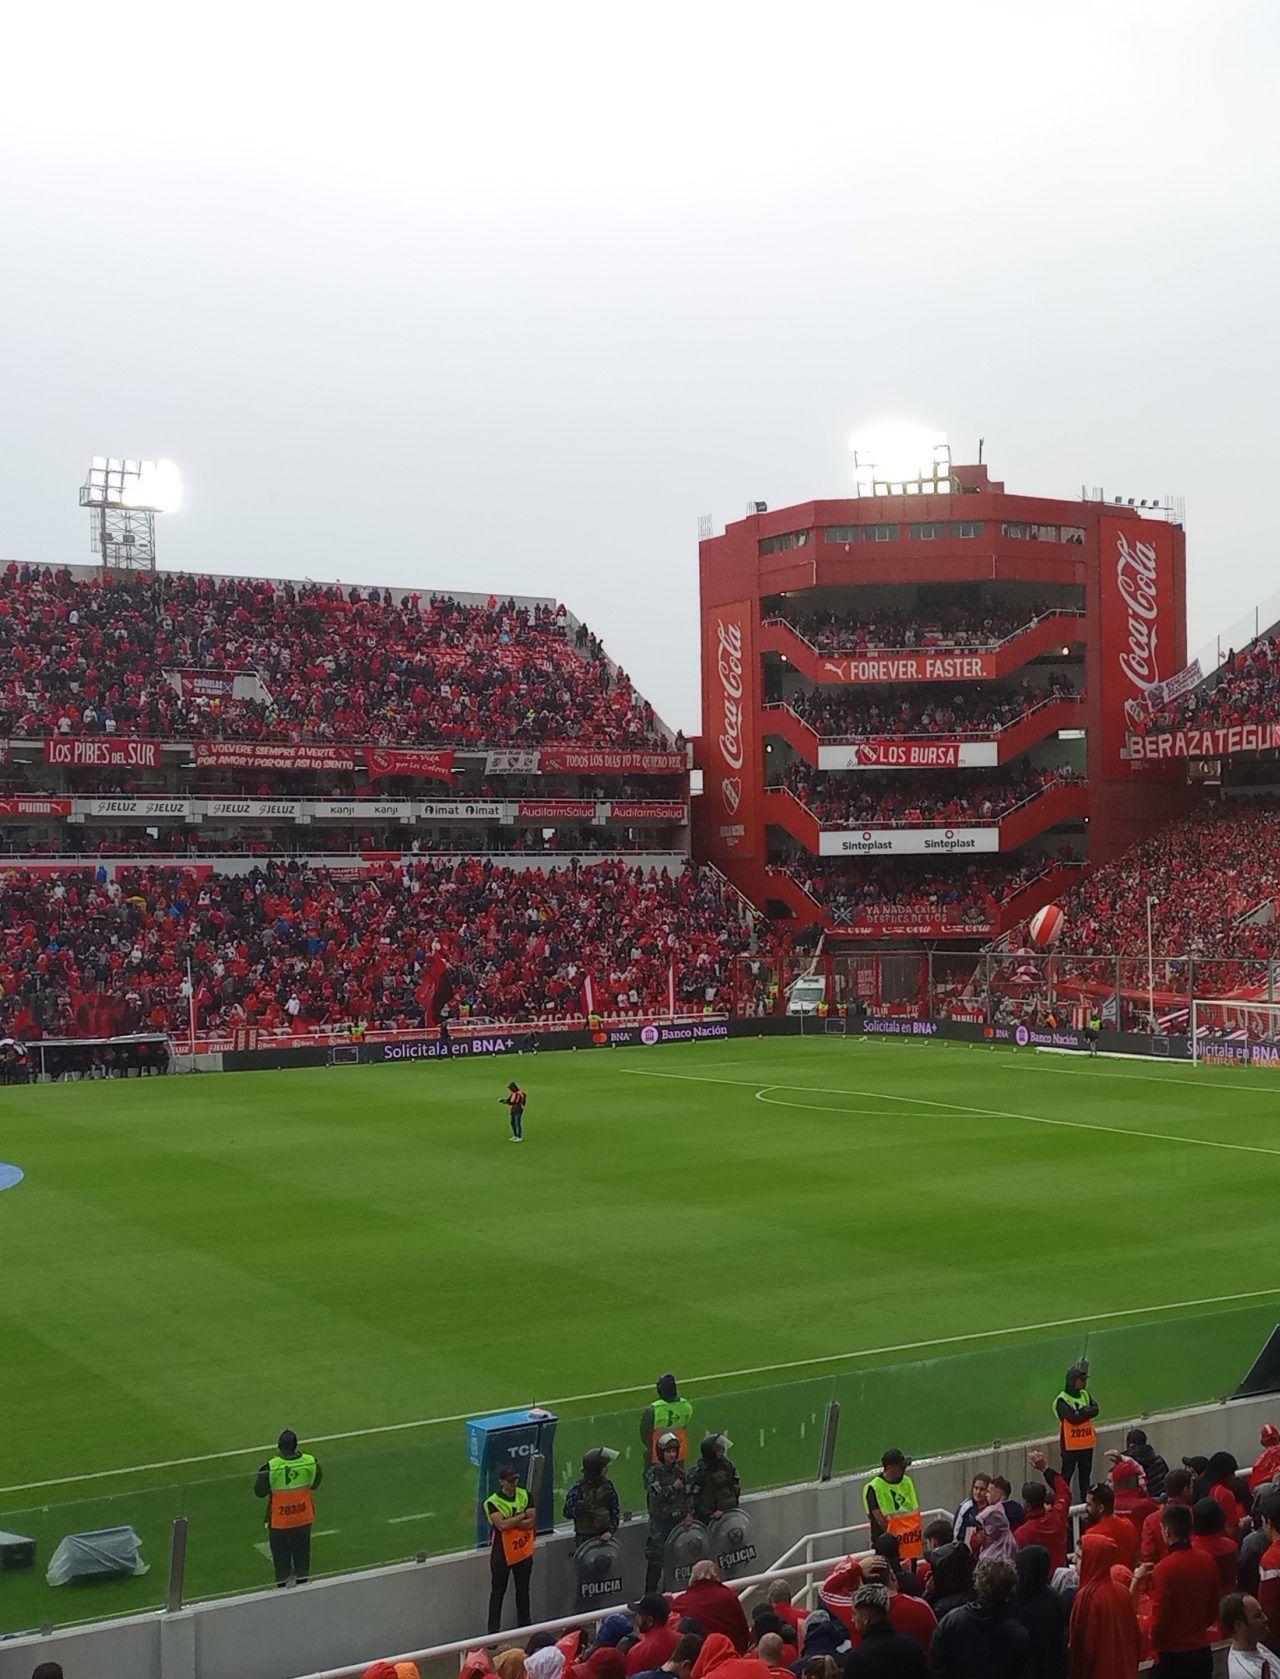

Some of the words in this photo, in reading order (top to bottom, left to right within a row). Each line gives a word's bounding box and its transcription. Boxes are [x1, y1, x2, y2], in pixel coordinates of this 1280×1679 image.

[850, 661, 922, 679] FOREVER.
[926, 658, 987, 678] FASTER.
[718, 618, 743, 770] Coca-Cola
[49, 741, 70, 763] LOS
[74, 741, 109, 764] PIBES
[111, 752, 126, 764] DEL
[128, 743, 155, 766] SUR
[211, 744, 253, 754] VOLVERE
[255, 746, 295, 756] SIEMPRE
[880, 749, 906, 764] LOS
[911, 747, 954, 765] BURSA
[196, 757, 216, 765] POR
[217, 757, 246, 766] AMOR
[323, 761, 354, 770] SIENTO
[590, 754, 602, 767] LOS
[18, 802, 50, 812] PUMA
[106, 802, 137, 812] JELUZ
[153, 803, 184, 813] JELUZ
[221, 804, 250, 813] JELUZ
[267, 805, 295, 814] JELUZ
[842, 840, 892, 851] Sinteplast
[924, 839, 975, 849] Sinteplast
[662, 1028, 692, 1040] Banco
[693, 1025, 727, 1038] Nación
[863, 1020, 900, 1033] Solicitala
[901, 1023, 911, 1033] en
[913, 1021, 938, 1034] BNA+
[1030, 1031, 1051, 1044] Banco
[1053, 1032, 1078, 1046] Nación
[384, 1041, 448, 1059] Solicitala
[452, 1043, 468, 1055] en
[473, 1038, 514, 1053] BNA+
[507, 1444, 538, 1458] TCL
[718, 1547, 756, 1568] POLICIA
[581, 1580, 622, 1595] POLICIA
